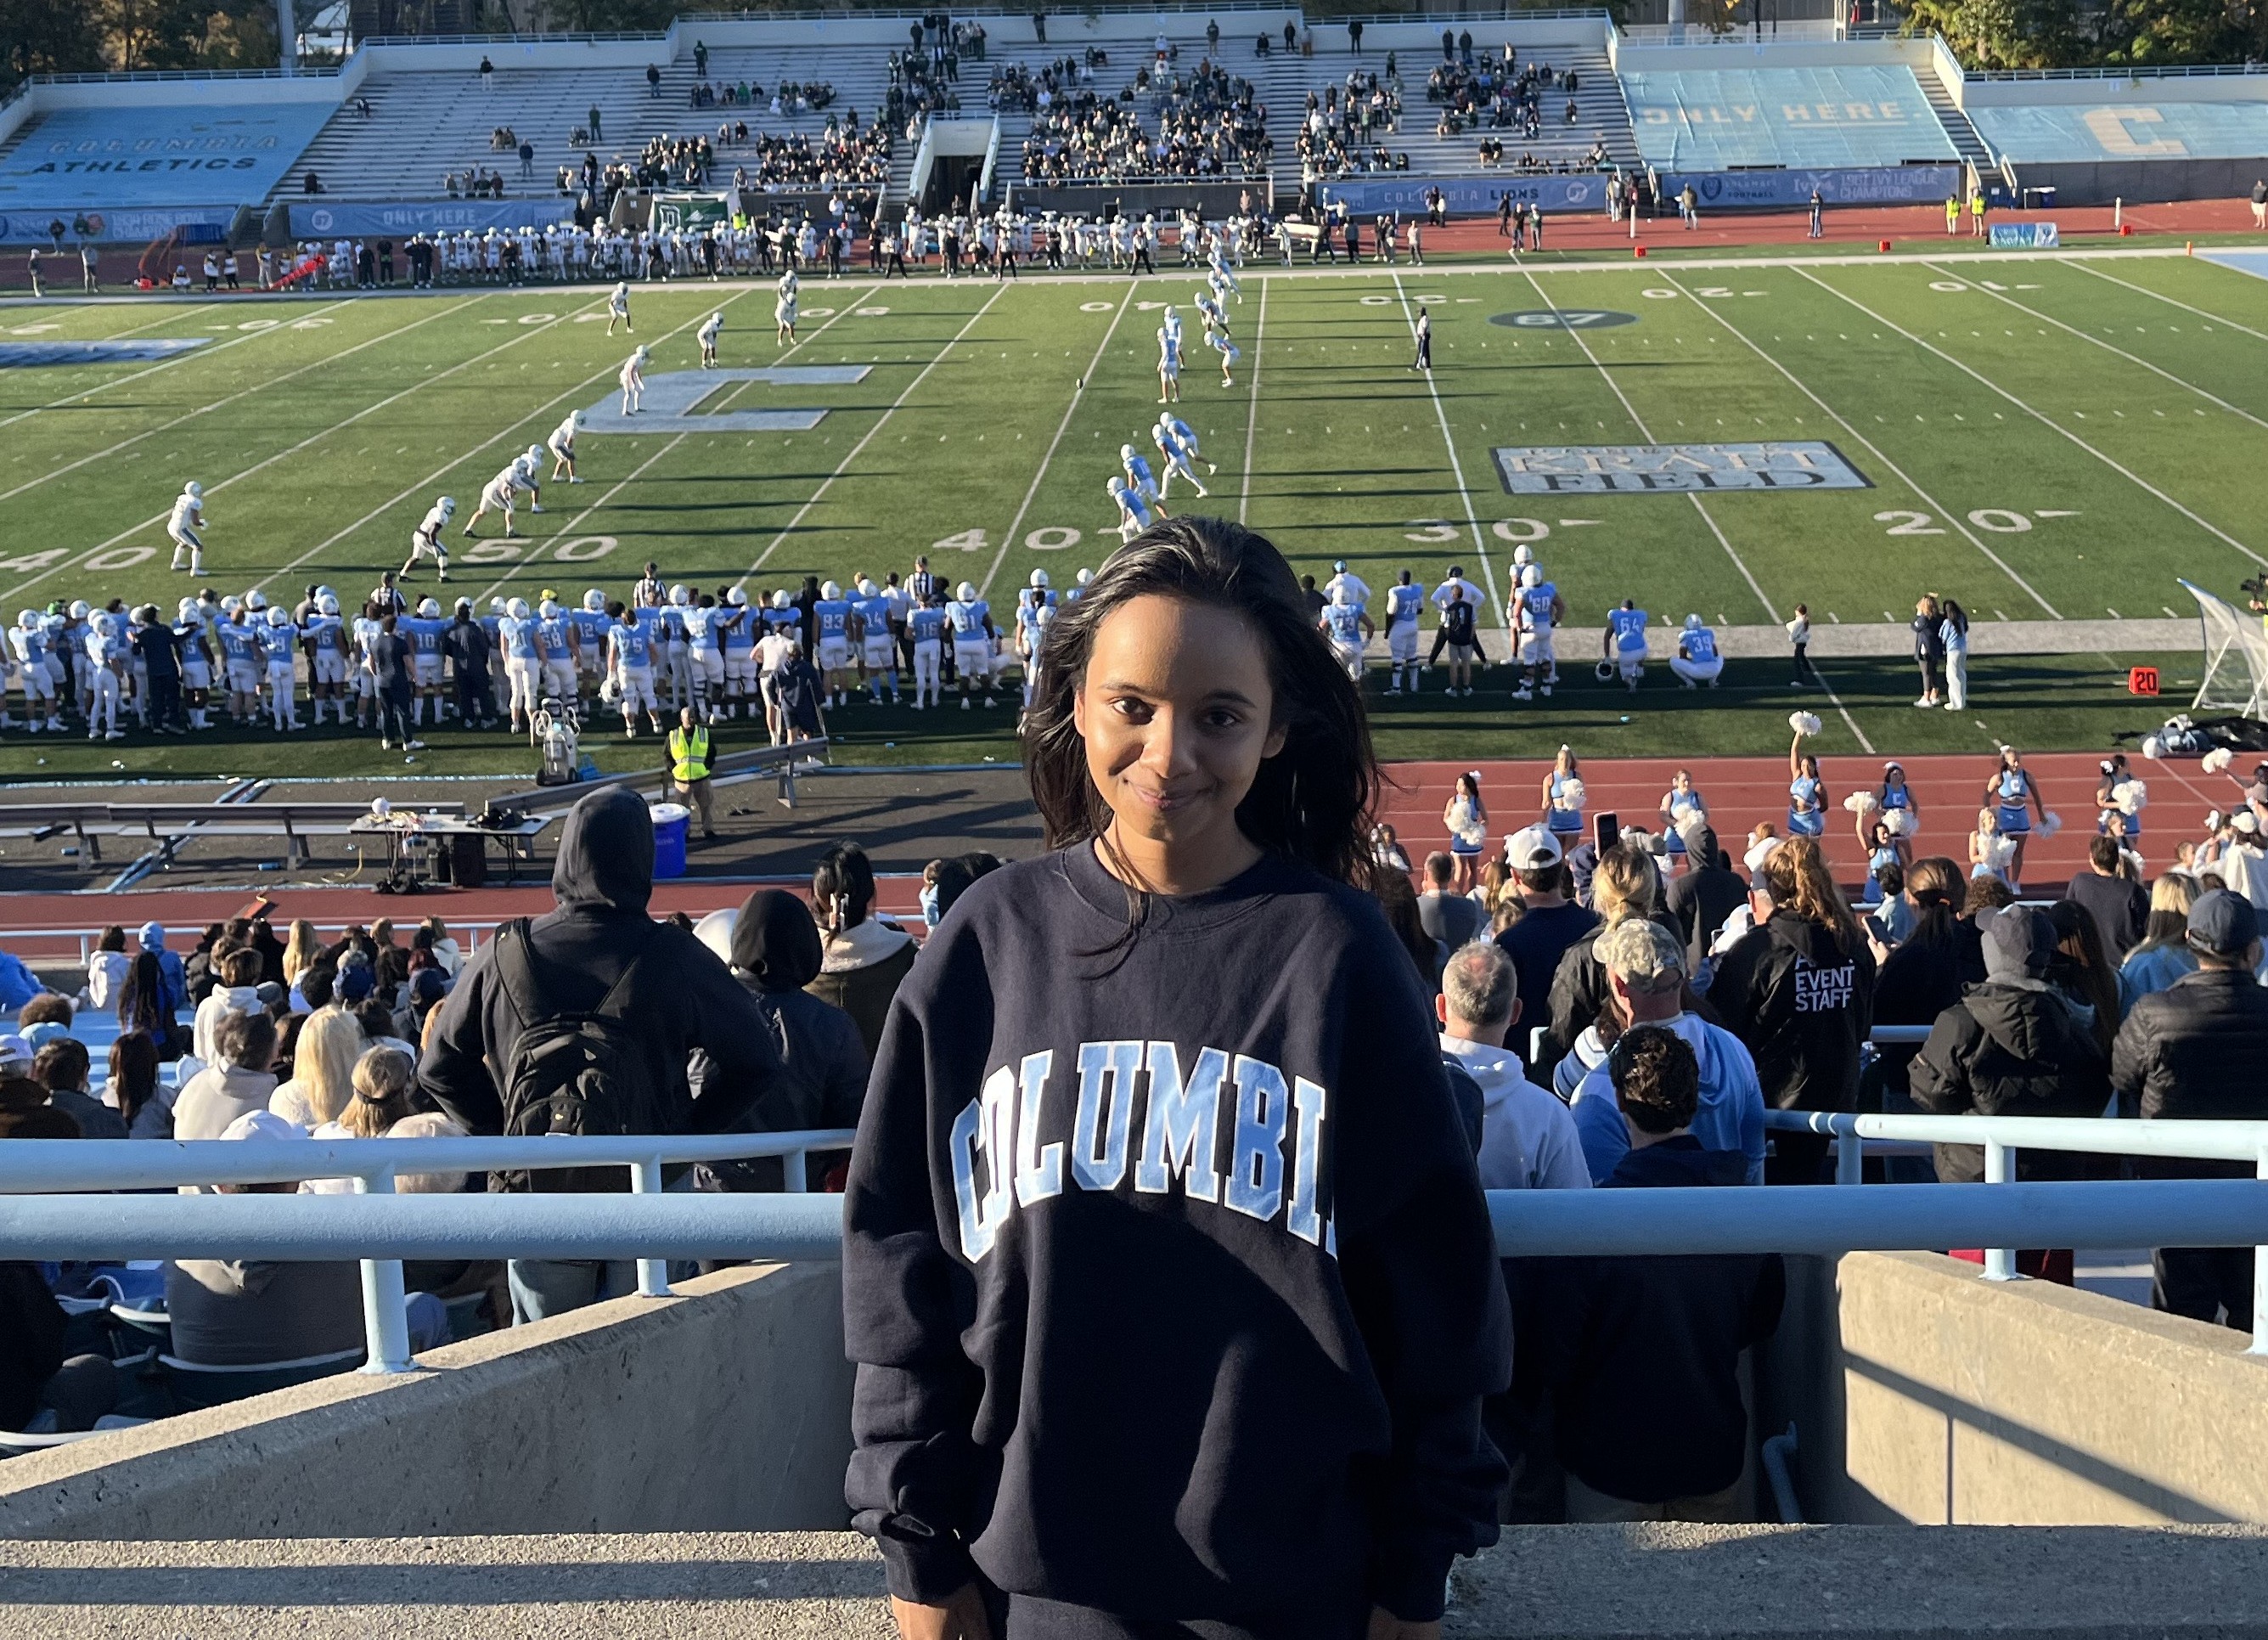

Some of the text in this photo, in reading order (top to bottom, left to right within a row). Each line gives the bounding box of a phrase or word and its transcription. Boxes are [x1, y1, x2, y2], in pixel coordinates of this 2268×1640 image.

[2082, 107, 2191, 156] C
[33, 156, 257, 173] ATHLETICS
[1894, 172, 1939, 185] LEAGUE
[1384, 188, 1539, 203] COLUBIA LIONS
[1840, 184, 1912, 199] CHAMPIONS
[383, 211, 425, 225] ONLY
[1510, 450, 1832, 473] KRAFT
[1540, 470, 1826, 490] FIELD
[1403, 518, 1550, 542] 30
[1873, 509, 2033, 535] 20
[460, 536, 618, 563] 50
[932, 527, 1082, 552] 40
[0, 546, 157, 572] 40
[823, 614, 844, 629] 83
[865, 611, 882, 628] 14
[1619, 617, 1640, 633] 64
[416, 632, 436, 650] 10
[1694, 635, 1712, 653] 39
[2136, 671, 2157, 692] 20
[1795, 965, 1855, 992] EVENT
[1795, 988, 1853, 1012] STAFF
[949, 1040, 1338, 1264] COLUMBI
